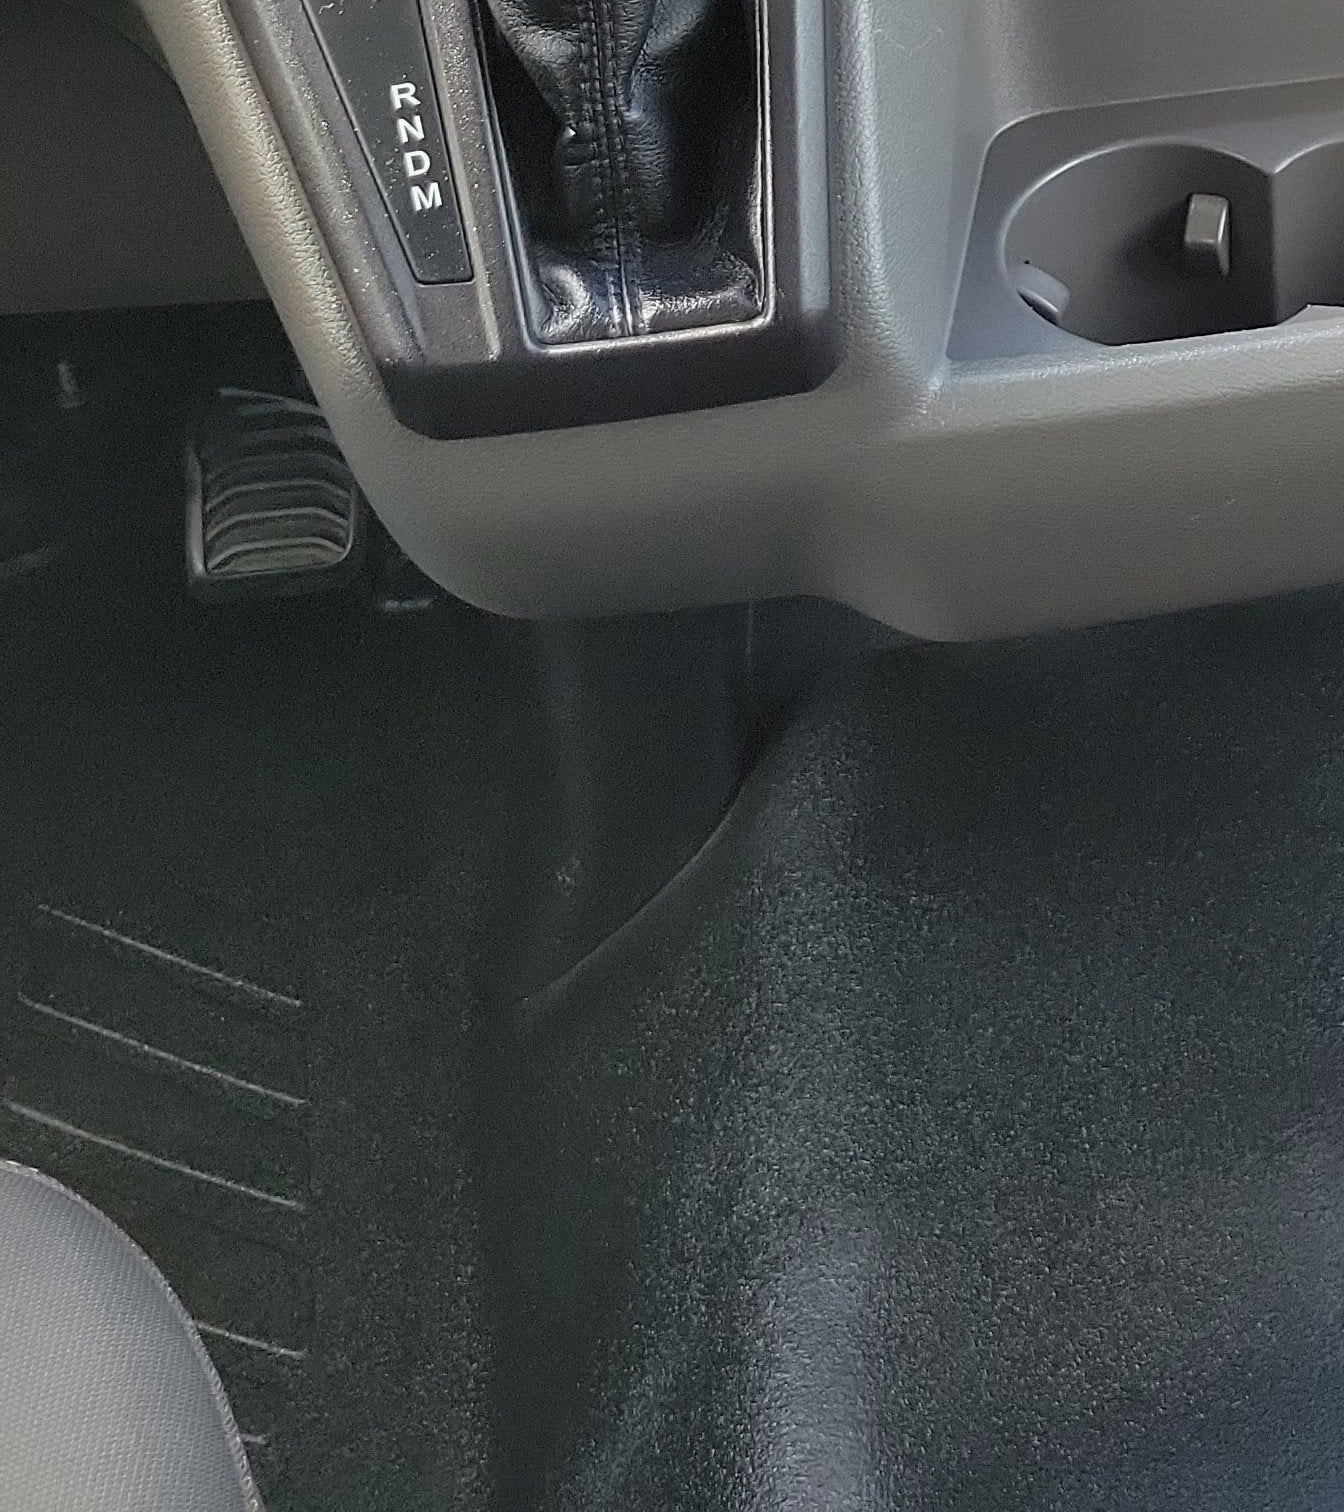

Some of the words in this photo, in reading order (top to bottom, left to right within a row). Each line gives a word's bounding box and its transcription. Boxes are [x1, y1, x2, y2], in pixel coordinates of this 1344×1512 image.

[390, 82, 421, 111] R
[396, 115, 425, 144] N
[403, 149, 432, 178] D
[410, 182, 442, 212] M
